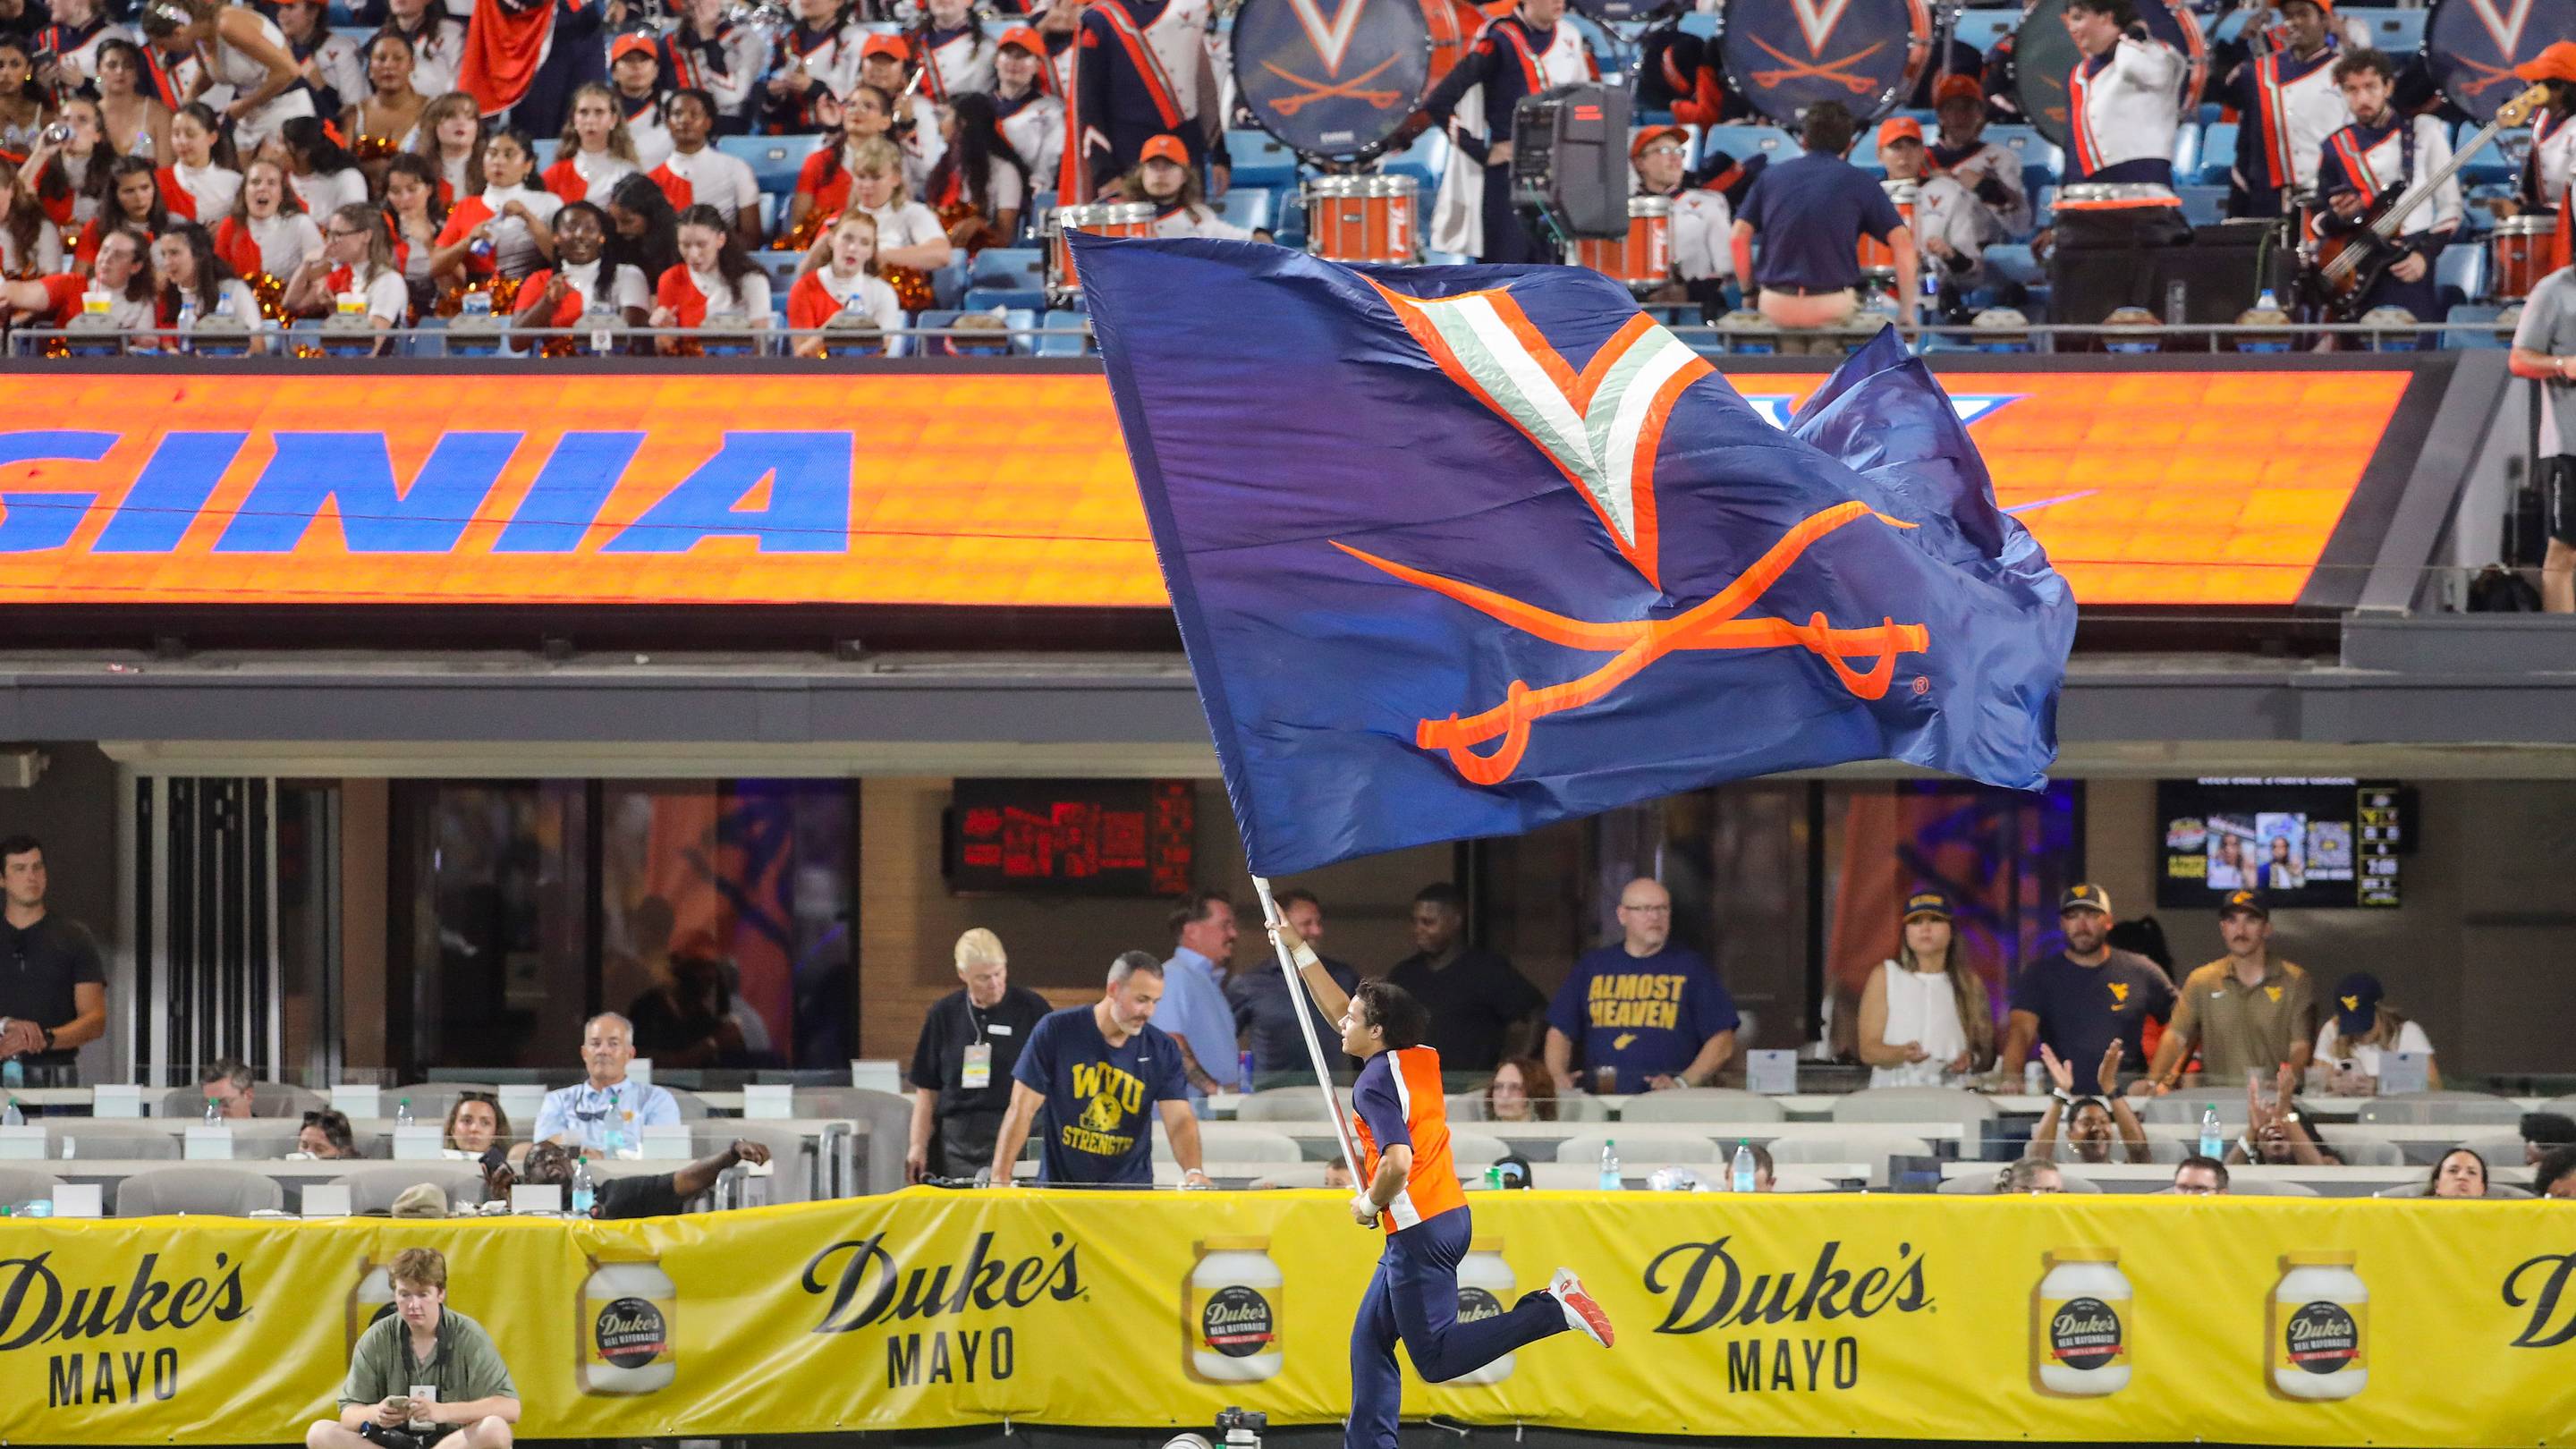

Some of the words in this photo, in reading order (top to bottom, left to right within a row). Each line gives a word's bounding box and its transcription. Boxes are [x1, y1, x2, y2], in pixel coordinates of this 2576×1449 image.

[1588, 973, 1688, 1002] ALMOST
[1589, 1000, 1678, 1030] HEAVEN
[1072, 1062, 1145, 1115] WVU
[0, 1251, 252, 1352] Duke's
[801, 1232, 1088, 1333] Duke's
[1643, 1235, 1935, 1335] Duke's
[599, 1313, 660, 1335] Duke's
[1206, 1302, 1267, 1325] Duke's
[2054, 1314, 2117, 1336] Duke's
[2290, 1318, 2352, 1341] Duke's
[49, 1347, 178, 1408] MAYO
[887, 1326, 1013, 1389] MAYO
[1728, 1336, 1858, 1393] MAYO
